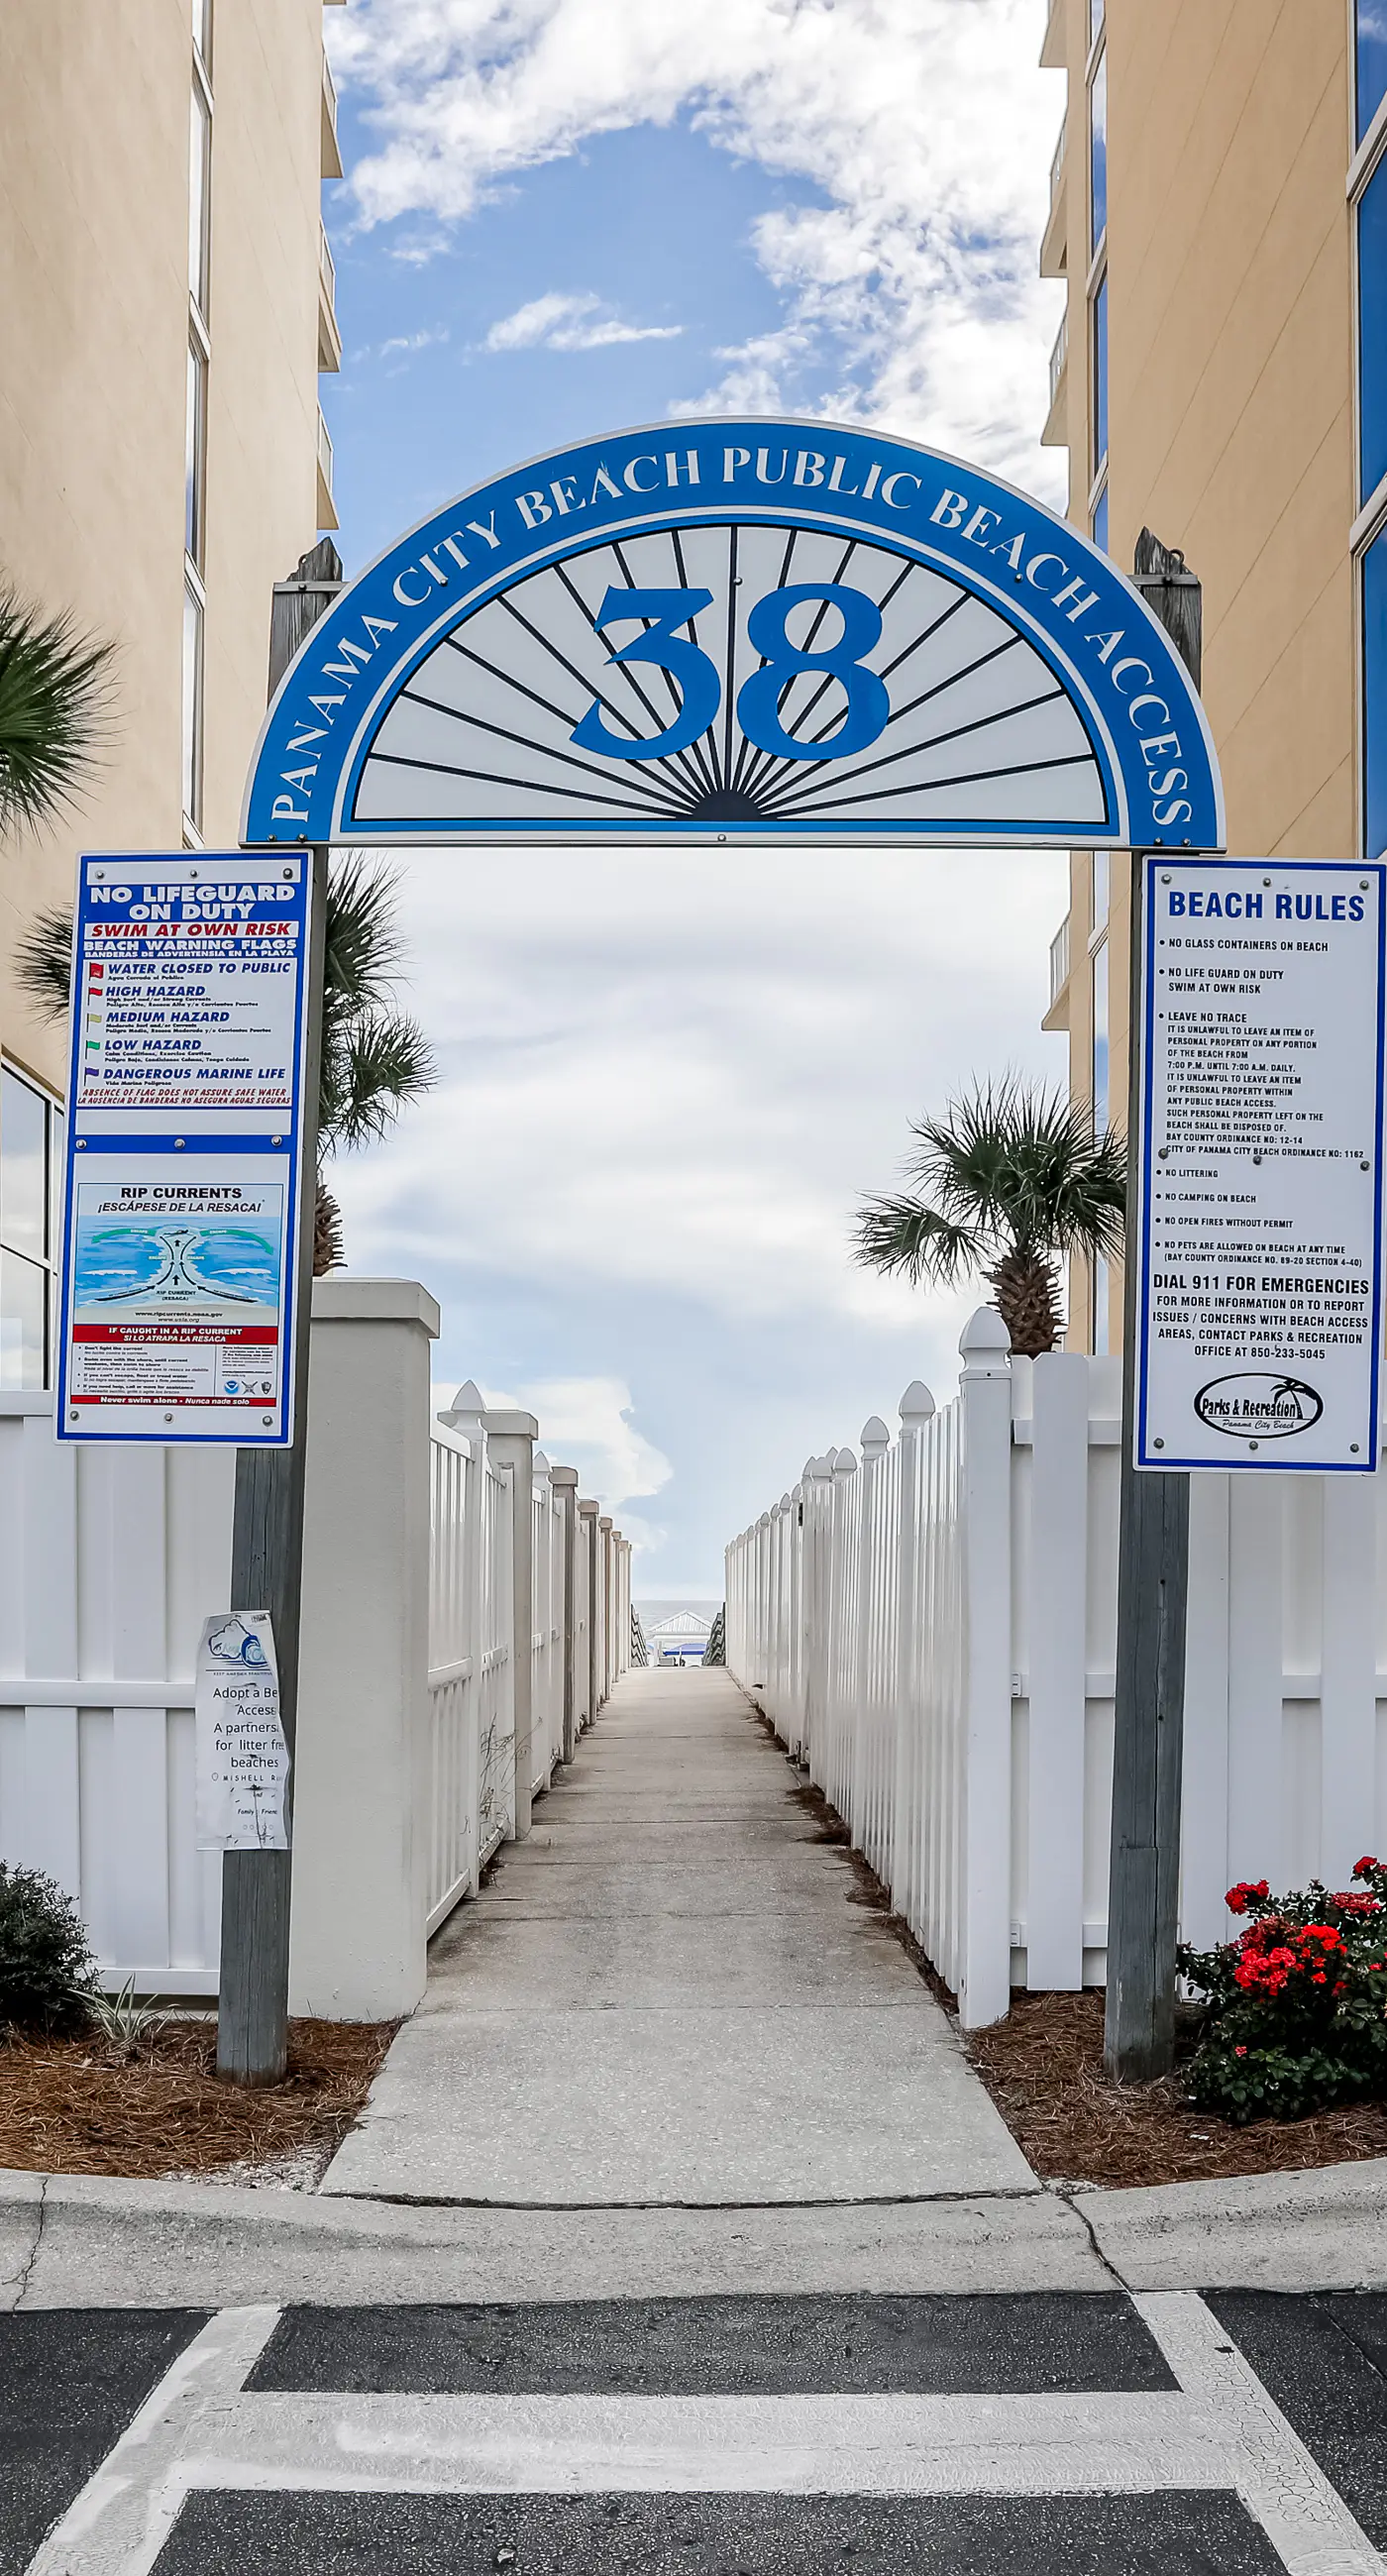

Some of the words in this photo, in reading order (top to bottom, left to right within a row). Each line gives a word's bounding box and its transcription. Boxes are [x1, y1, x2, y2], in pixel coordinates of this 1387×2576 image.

[271, 614, 399, 821] PANAMA
[392, 510, 502, 606] CITY
[515, 449, 700, 530] BEACH
[722, 446, 922, 509] PUBLIC
[929, 488, 1101, 623] BEACH
[1084, 629, 1193, 825] ACCESS
[569, 583, 891, 761] 38
[90, 886, 133, 903] NO
[143, 885, 295, 903] LIFEGUARD
[129, 904, 170, 920] ON
[181, 903, 255, 919] DUTY
[1169, 892, 1262, 918] BEACH
[1275, 894, 1364, 921] RULES
[91, 923, 148, 937] SWIM
[154, 923, 181, 937] AT
[186, 922, 239, 936] OWN
[244, 922, 291, 935] RISK
[83, 940, 139, 951] BEACH
[145, 939, 235, 950] WARNING
[241, 939, 296, 949] FLAGS
[1168, 938, 1182, 947] NO
[1185, 938, 1215, 949] GLASS
[1217, 939, 1277, 950] CONTAINERS
[1280, 941, 1293, 951] ON
[1296, 941, 1328, 951] BEACH
[108, 963, 157, 974] WATER
[160, 963, 213, 974] CLOSED
[218, 963, 237, 973] TO
[241, 962, 290, 973] PUBLIC
[1168, 968, 1181, 977] NO
[1185, 968, 1205, 978] LIFE
[1208, 969, 1240, 979] GUARD
[1242, 970, 1256, 979] ON
[1259, 970, 1284, 980] DUTY
[105, 986, 142, 997] HIGH
[146, 986, 205, 997] HAZARD
[1168, 983, 1195, 992] SWIM
[1198, 983, 1211, 993] AT
[1213, 983, 1235, 993] OWN
[1238, 984, 1260, 994] RISK
[105, 1012, 164, 1022] MEDIUM
[169, 1012, 230, 1022] HAZARD
[1168, 1013, 1197, 1021] LEAVE
[1200, 1013, 1214, 1022] NO
[1216, 1013, 1246, 1022] TRACE
[104, 1040, 139, 1050] LOW
[142, 1040, 202, 1050] HAZARD
[103, 1069, 192, 1079] DANGEROUS
[195, 1068, 254, 1079] MARINE
[257, 1068, 285, 1079] LIFE
[1178, 1169, 1219, 1178] LITTERING
[121, 1188, 148, 1198] RIP
[153, 1188, 242, 1199] CURRENTS
[1178, 1193, 1215, 1202] CAMPING
[1230, 1194, 1256, 1203] BEACH
[168, 1202, 186, 1212] DE
[187, 1202, 204, 1212] LA
[206, 1202, 262, 1213] RESACA!
[1201, 1218, 1224, 1227] FIRES
[1225, 1219, 1261, 1228] WITHOUT
[1153, 1274, 1187, 1289] DIAL
[1192, 1275, 1219, 1290] 911
[1226, 1276, 1255, 1291] FOR
[1261, 1276, 1369, 1294] EMERGENCIES
[1156, 1296, 1177, 1306] FOR
[1180, 1296, 1211, 1307] MORE
[1215, 1297, 1286, 1309] INFORMATION
[1289, 1299, 1304, 1310] OR
[1307, 1300, 1321, 1311] TO
[1324, 1300, 1364, 1312] REPORT
[1152, 1312, 1189, 1323] ISSUES
[1200, 1313, 1256, 1325] CONCERNS
[1259, 1314, 1286, 1326] WITH
[1290, 1315, 1325, 1327] BEACH
[1327, 1316, 1368, 1328] ACCESS
[1157, 1329, 1195, 1341] AREAS,
[1199, 1330, 1246, 1341] CONTACT
[1249, 1331, 1283, 1342] PARKS
[1286, 1332, 1294, 1342] &
[1298, 1332, 1362, 1343] RECREATION
[1194, 1345, 1231, 1356] OFFICE
[1234, 1346, 1247, 1357] AT
[1250, 1346, 1325, 1359] 850-233-5045
[1202, 1398, 1230, 1415] Parks
[1232, 1399, 1240, 1415] &
[1242, 1398, 1296, 1417] Recreation
[1222, 1420, 1252, 1429] Panama
[1254, 1420, 1271, 1430] City
[1273, 1421, 1295, 1430] Beach
[213, 1687, 250, 1700] Adopt
[253, 1689, 260, 1698] a
[237, 1705, 276, 1715] Access
[214, 1723, 222, 1733] A
[226, 1724, 278, 1736] partners
[215, 1740, 233, 1751] for
[240, 1740, 267, 1751] litter
[231, 1757, 278, 1768] beaches
